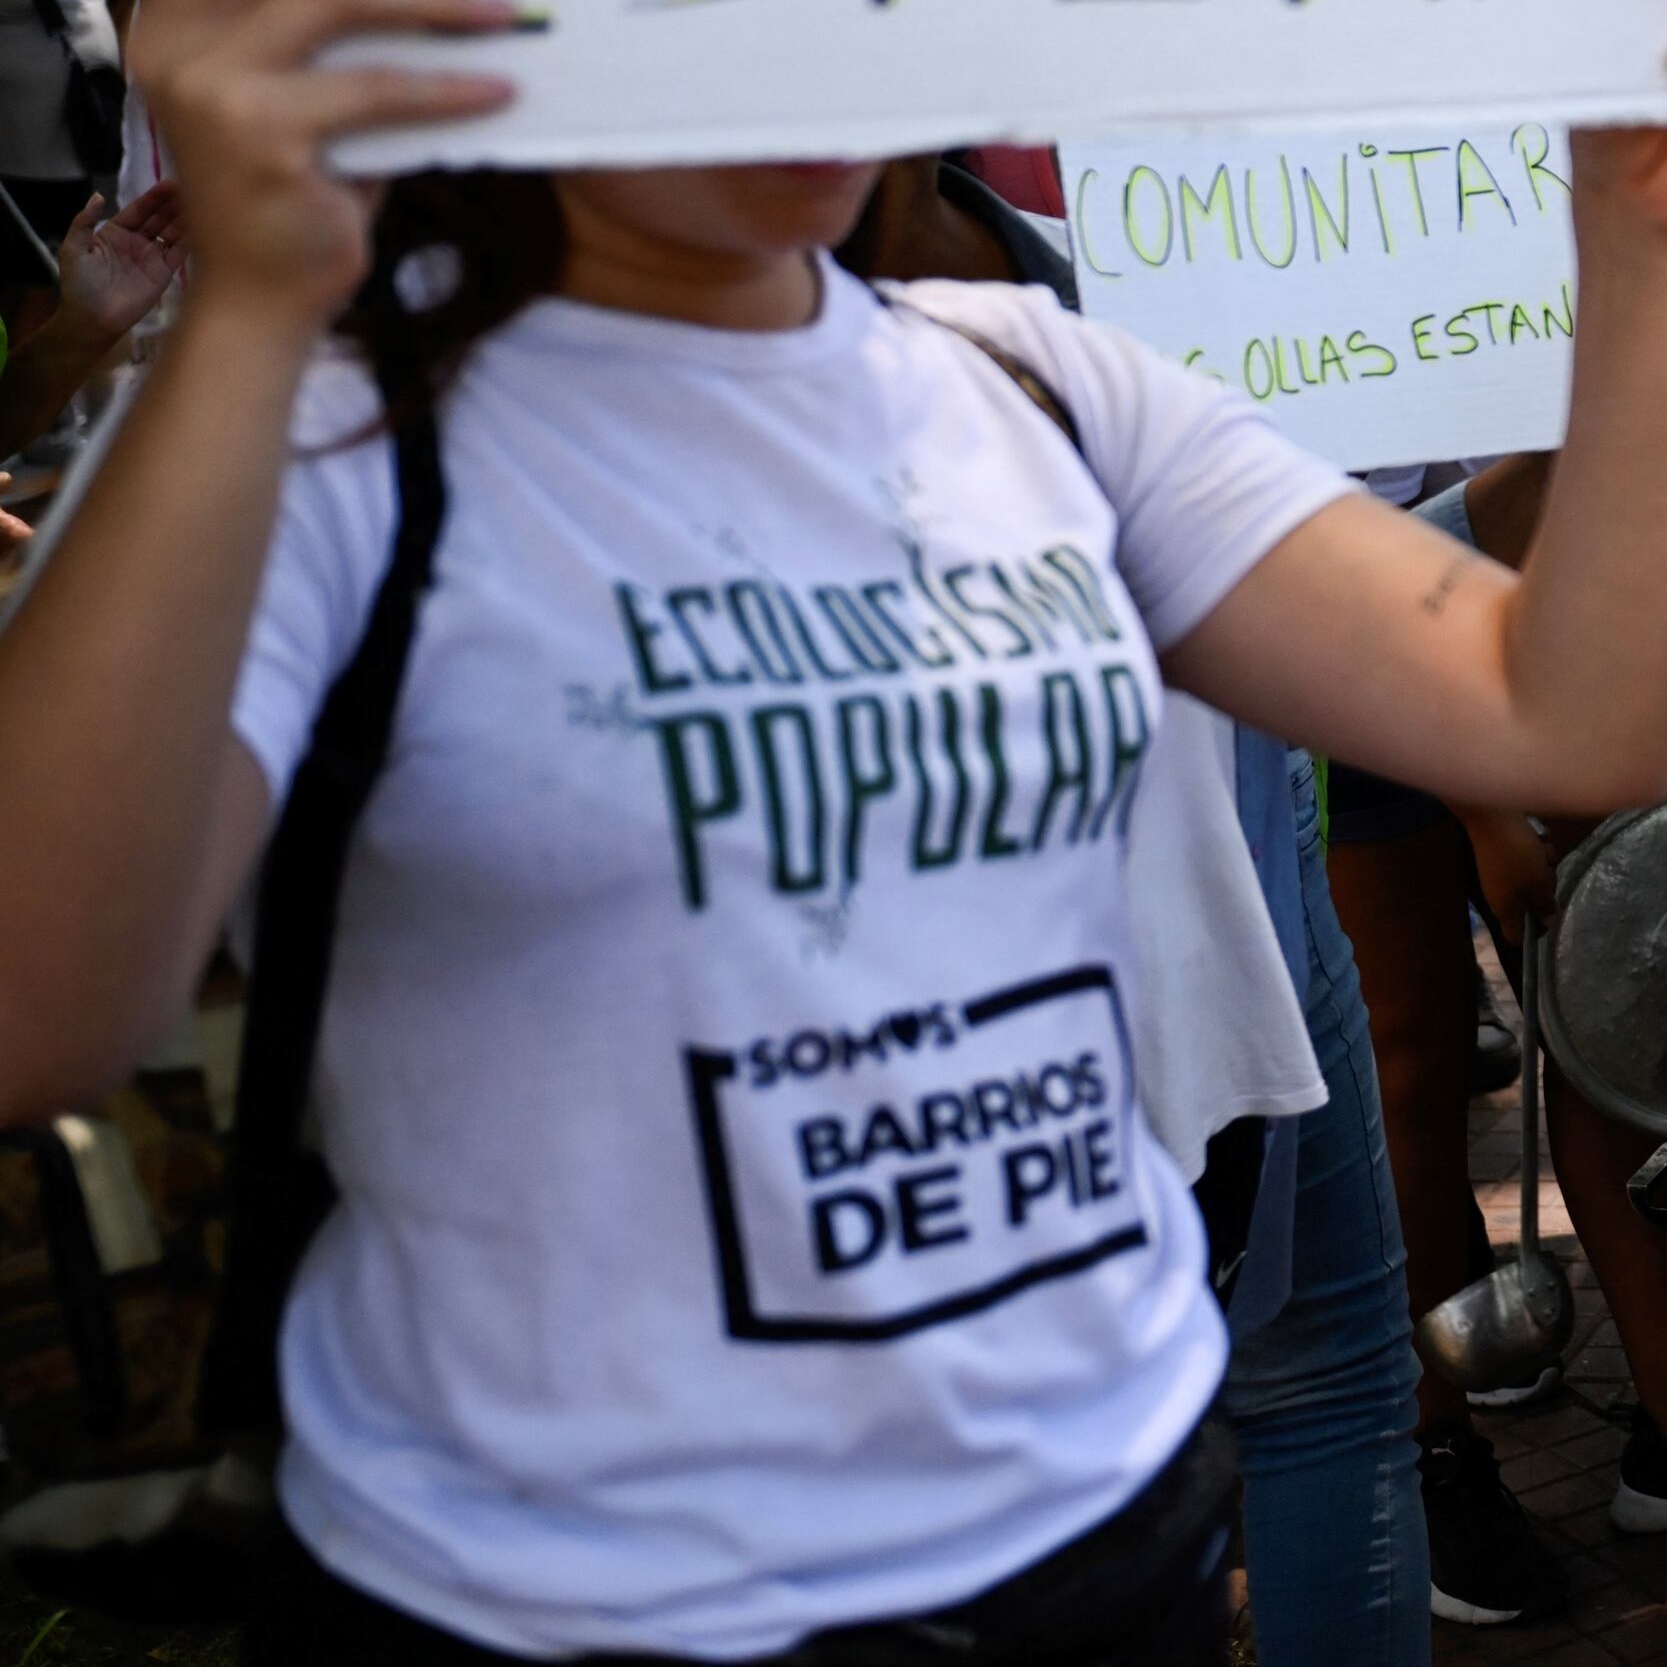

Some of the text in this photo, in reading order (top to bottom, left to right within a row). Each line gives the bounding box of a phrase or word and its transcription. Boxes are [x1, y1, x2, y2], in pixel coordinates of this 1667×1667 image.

[1244, 329, 1398, 400] OLLAS
[1411, 284, 1574, 361] ESTAN
[650, 659, 1156, 910] POPULAR
[796, 1052, 1107, 1181] BARRIOS
[809, 1120, 1121, 1276] DE PIE
